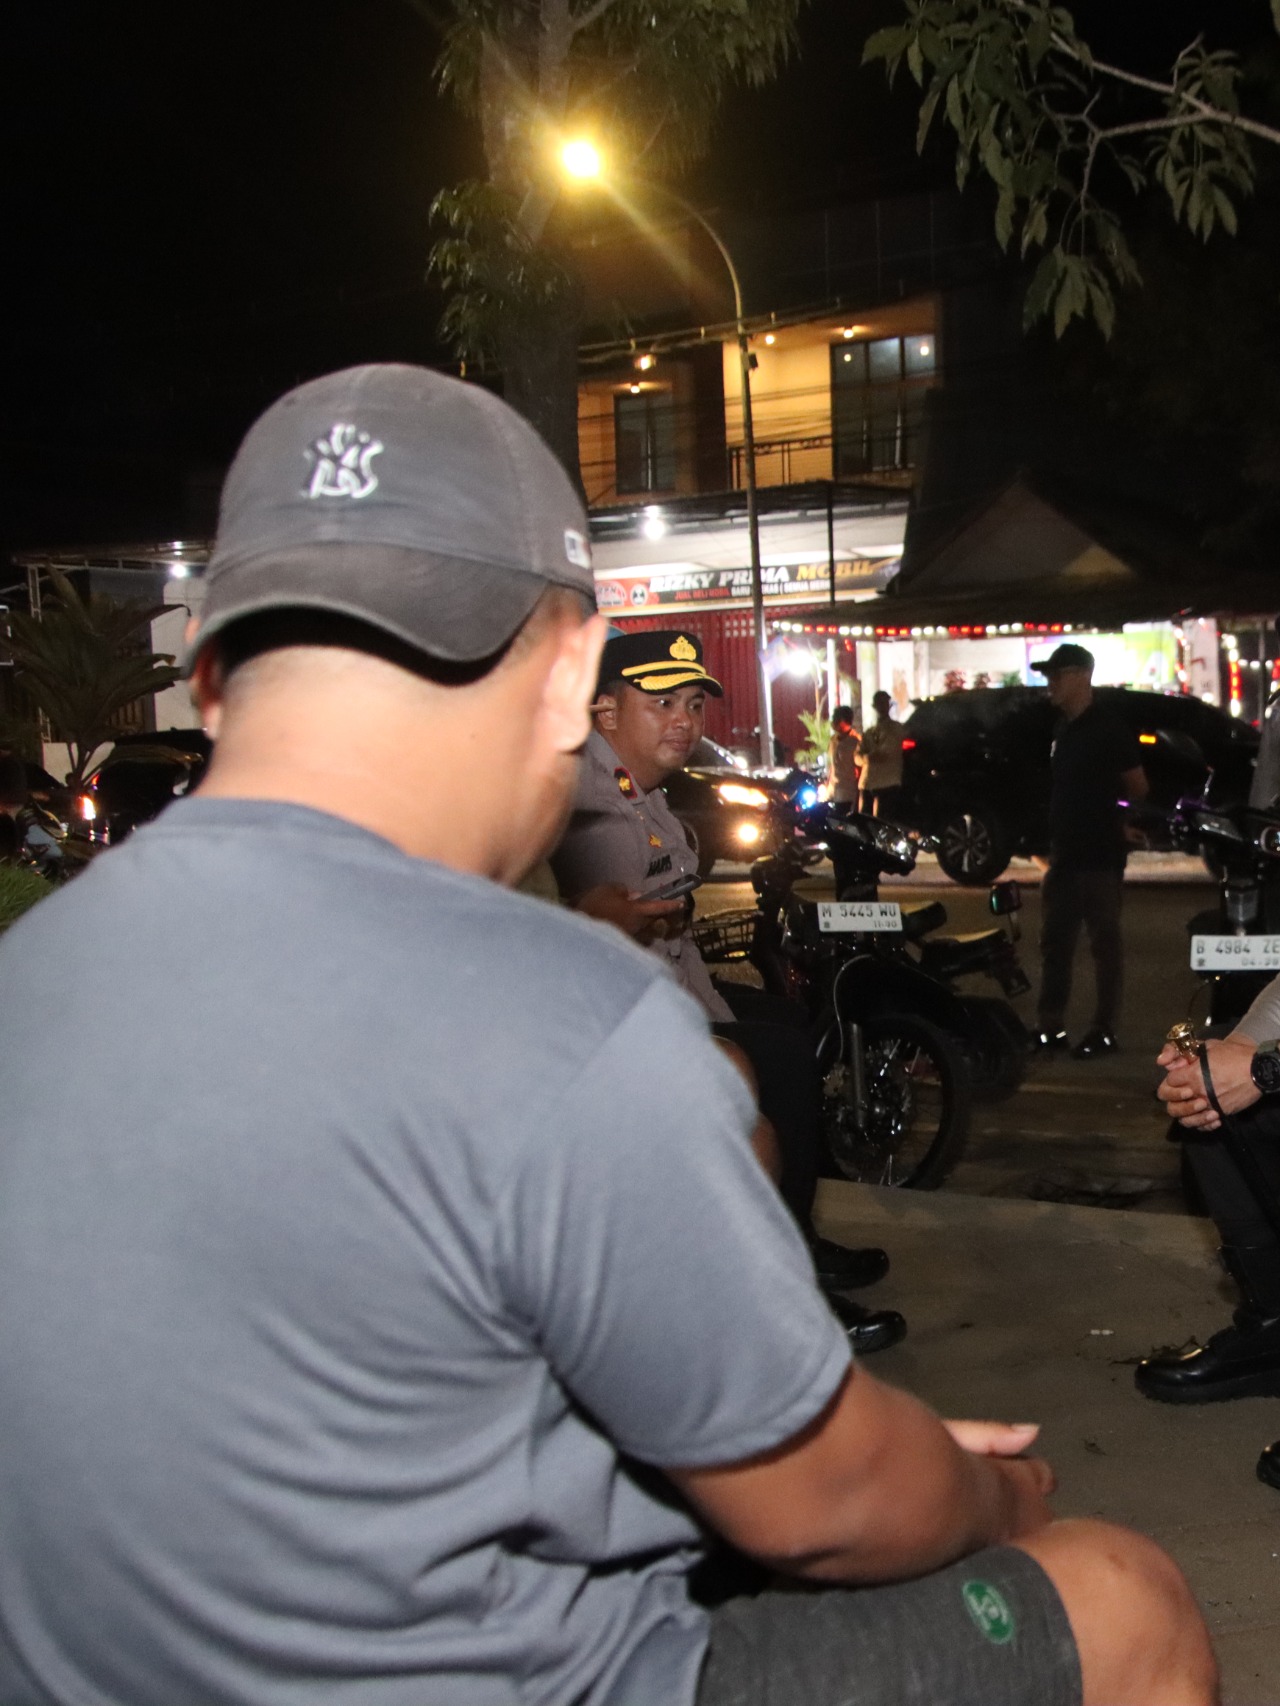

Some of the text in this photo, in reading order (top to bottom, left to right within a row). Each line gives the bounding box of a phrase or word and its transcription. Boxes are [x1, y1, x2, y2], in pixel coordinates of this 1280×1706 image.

[648, 560, 874, 592] RIZKY PRIMA MOBIL
[822, 904, 832, 918] M
[1263, 938, 1280, 954] ZE
